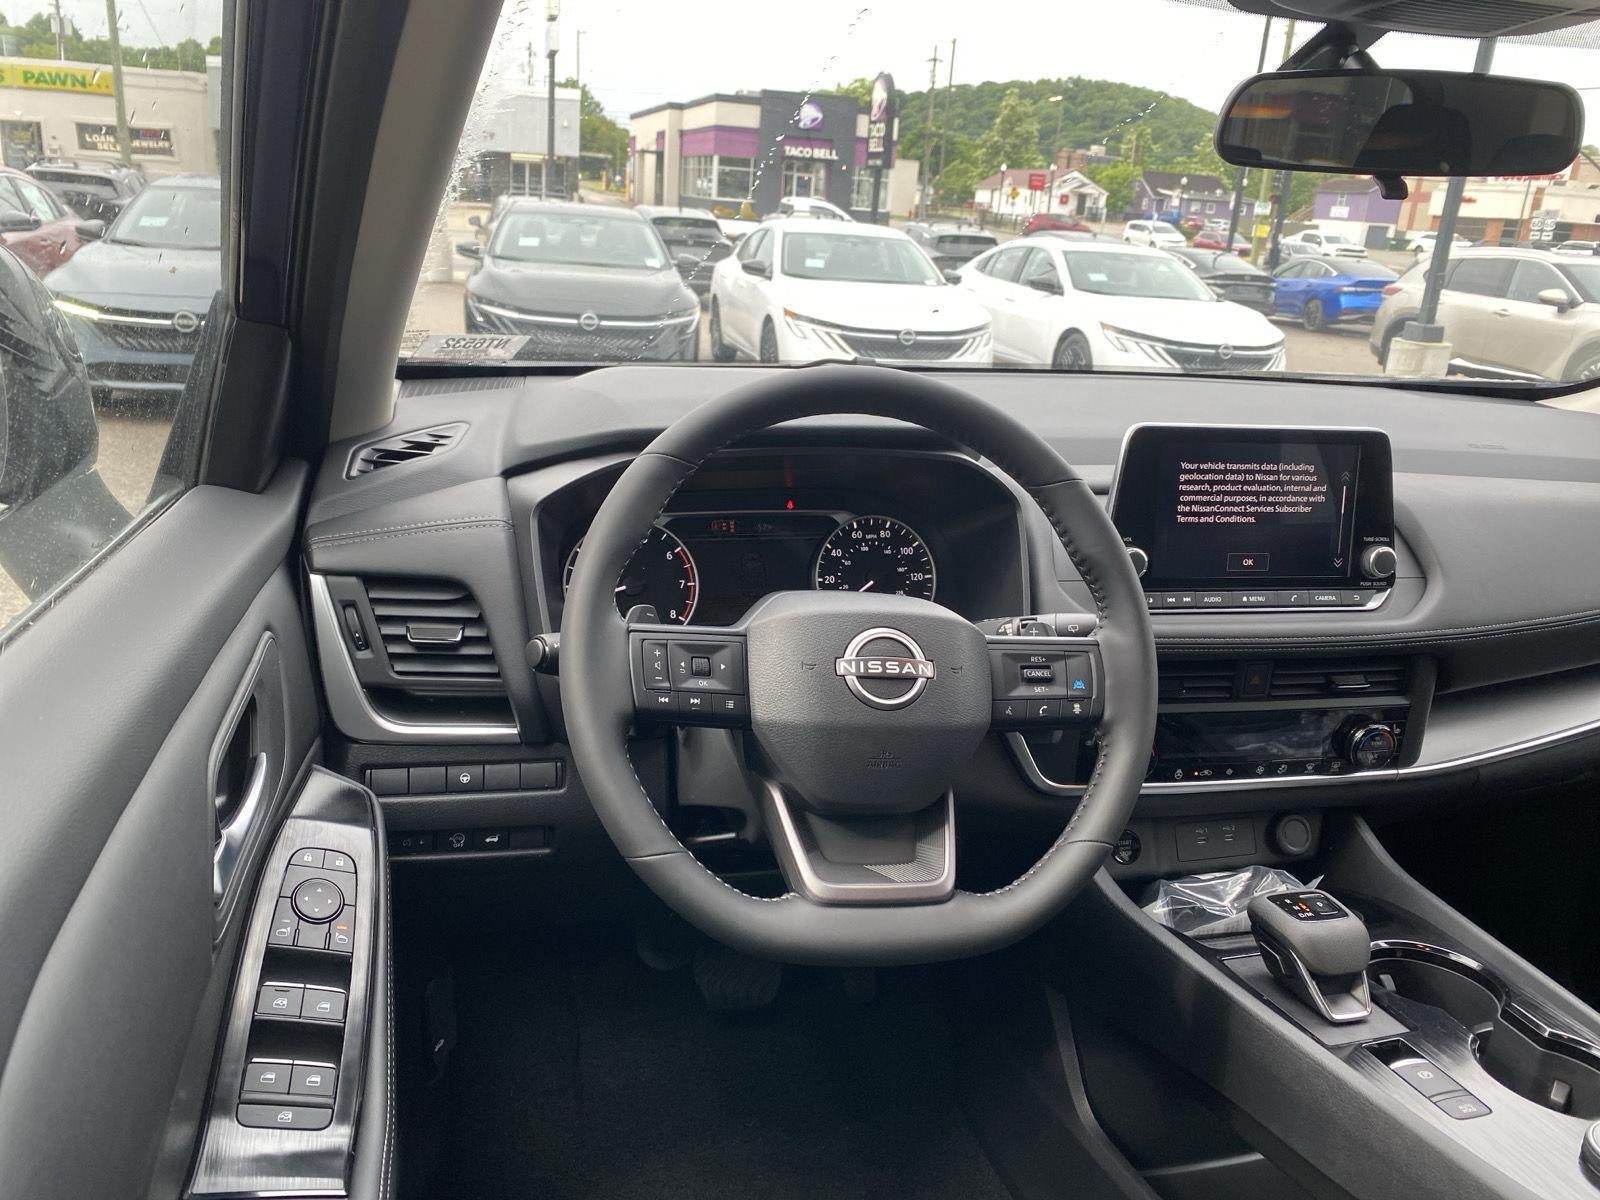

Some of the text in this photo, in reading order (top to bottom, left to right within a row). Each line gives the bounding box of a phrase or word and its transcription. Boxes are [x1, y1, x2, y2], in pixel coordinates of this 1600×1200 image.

[784, 145, 840, 160] TACO BELL
[1181, 461, 1315, 473] Your vehicle transmits data (including
[1179, 472, 1224, 482] geolocation
[1225, 472, 1245, 482] data)
[1255, 473, 1279, 481] Nissan
[1279, 473, 1290, 481] for
[1291, 473, 1317, 482] various
[1179, 483, 1327, 493] research, product evaluation, internal and
[1180, 494, 1326, 503] commercial purposes, in accordance with
[1177, 504, 1313, 513] the NissanConnect Services Subscriber
[1176, 514, 1256, 523] Terms and Conditions.
[851, 530, 863, 539] 60
[879, 530, 891, 539] 80
[666, 551, 673, 560] 6
[830, 548, 842, 557] 40
[900, 546, 914, 556] 100
[1242, 558, 1254, 566] OK
[824, 575, 835, 584] 20
[910, 572, 924, 581] 120
[678, 579, 686, 589] 7
[670, 610, 677, 619] 8
[1030, 655, 1047, 663] RES+
[840, 660, 933, 676] NISSAN
